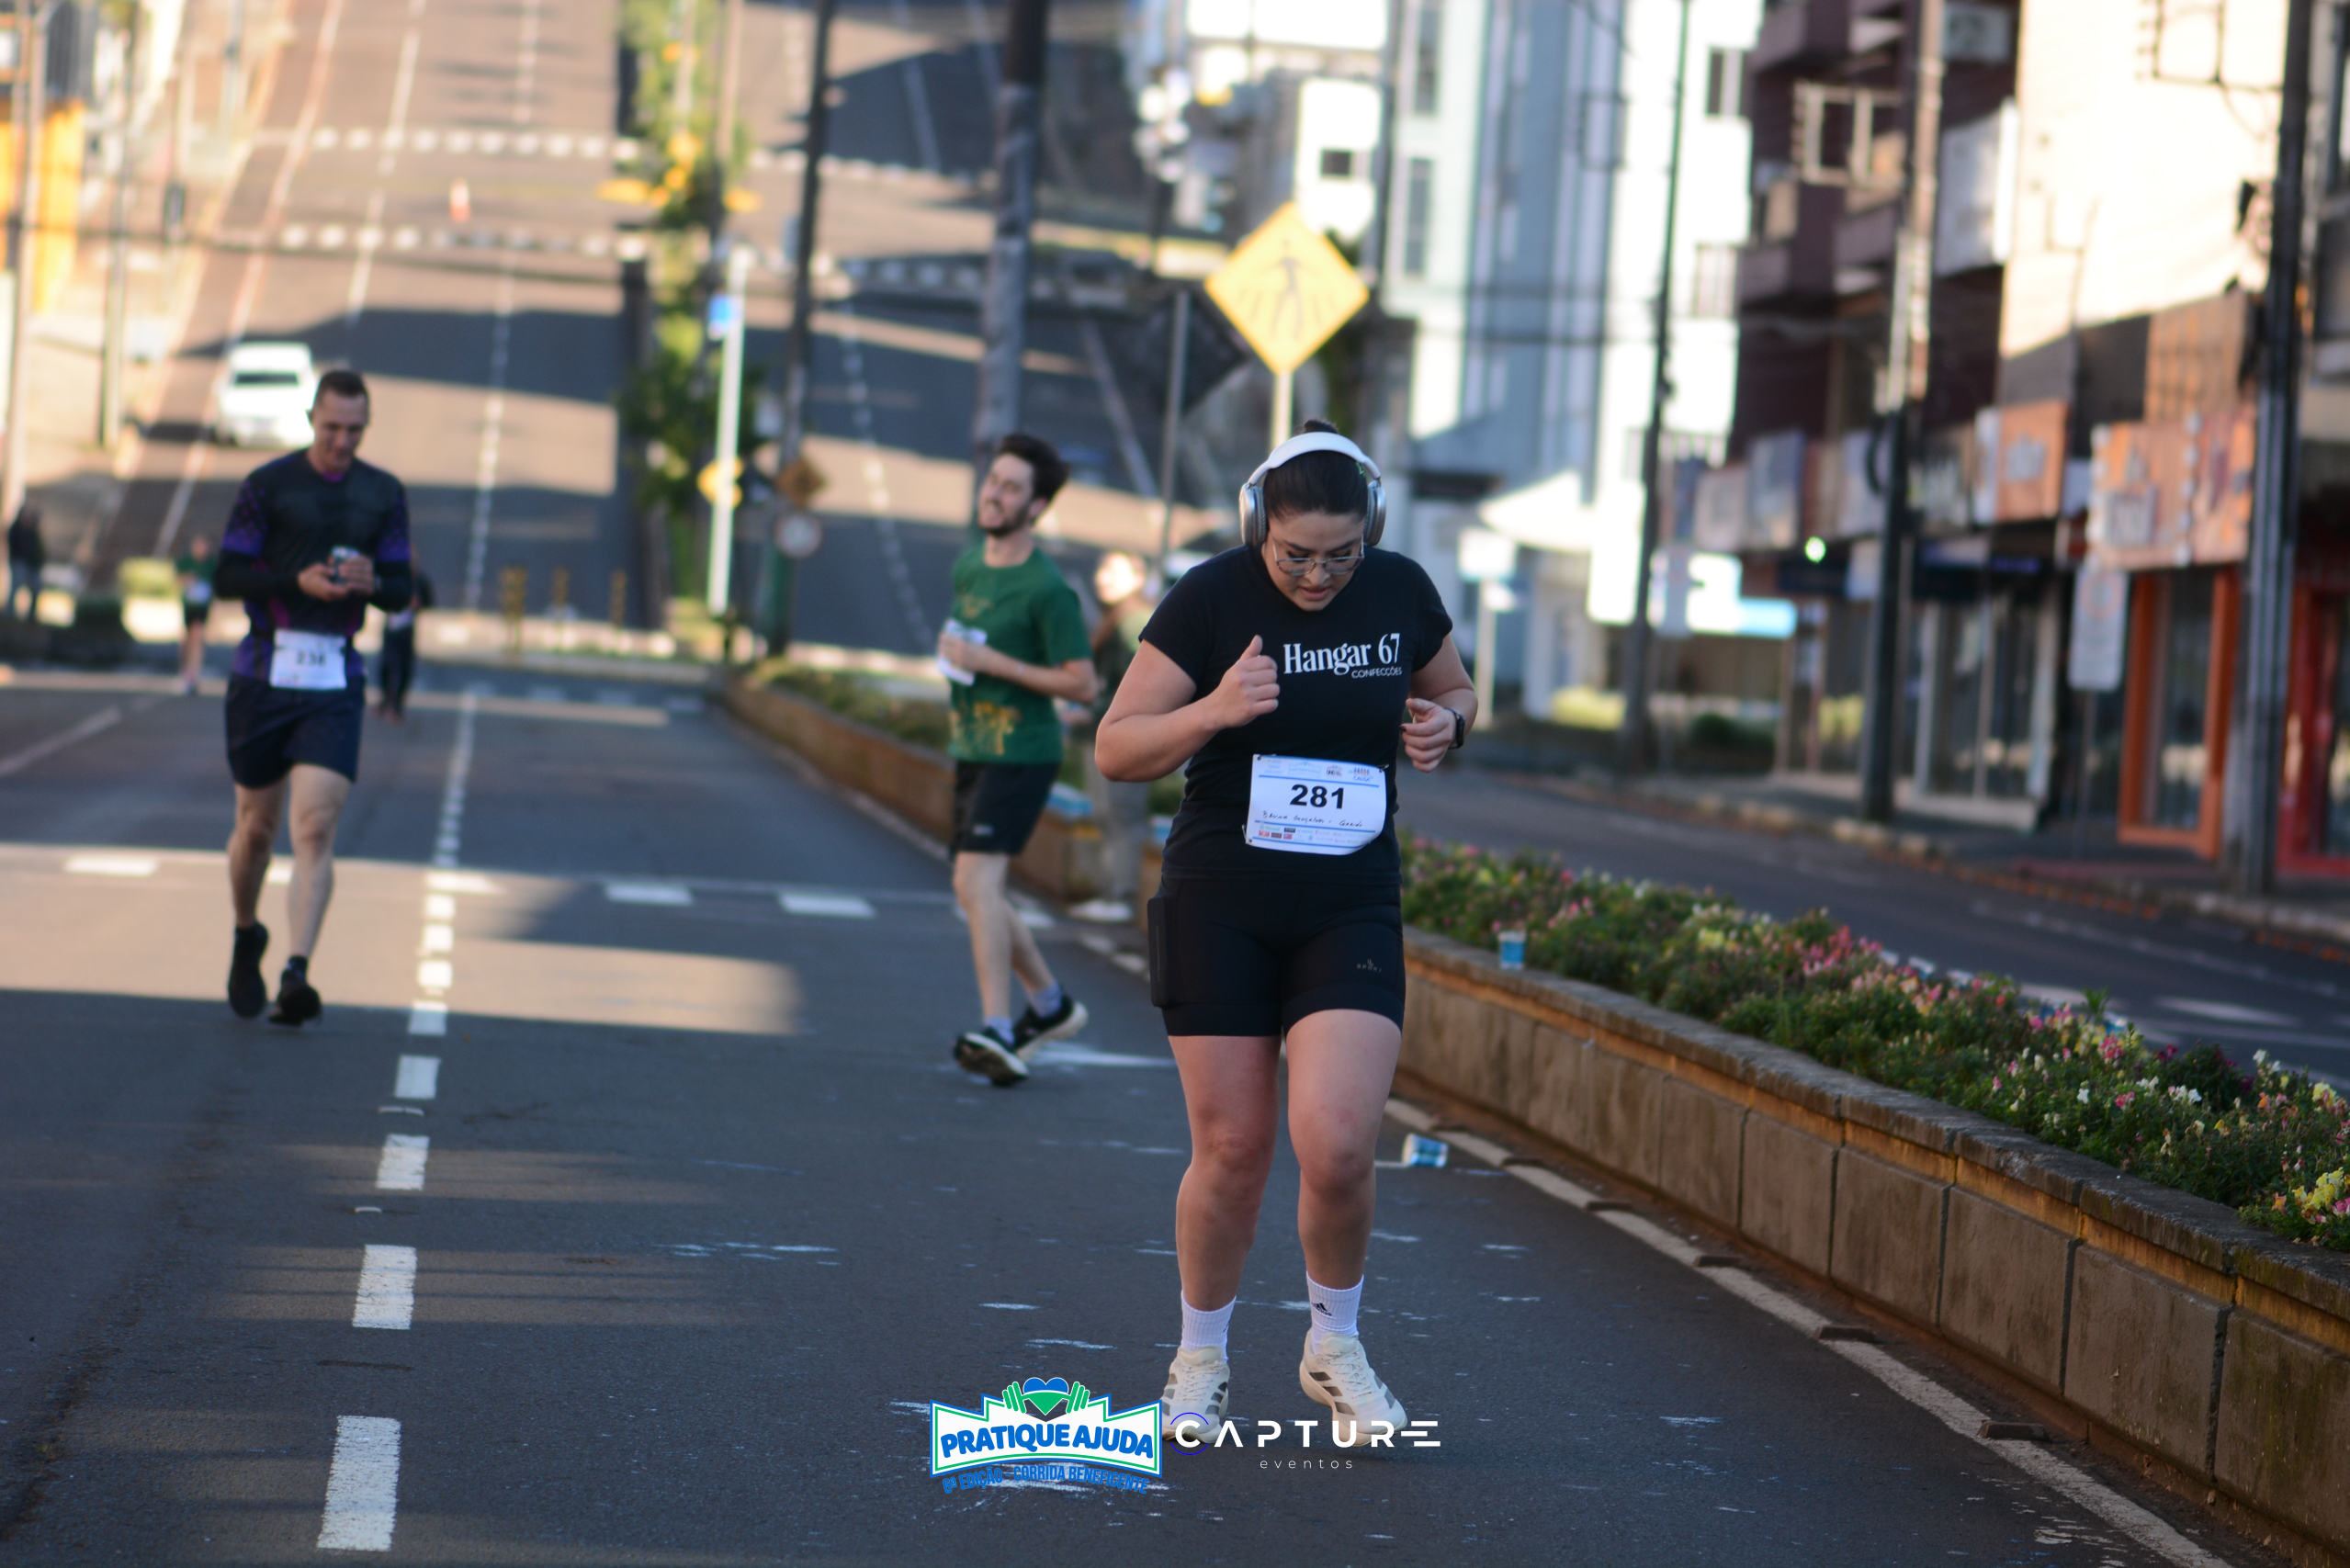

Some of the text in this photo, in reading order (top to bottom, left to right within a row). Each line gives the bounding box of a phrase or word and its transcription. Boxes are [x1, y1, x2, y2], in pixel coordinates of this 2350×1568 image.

[1282, 632, 1401, 676] Hangar 67
[1289, 784, 1345, 809] 281
